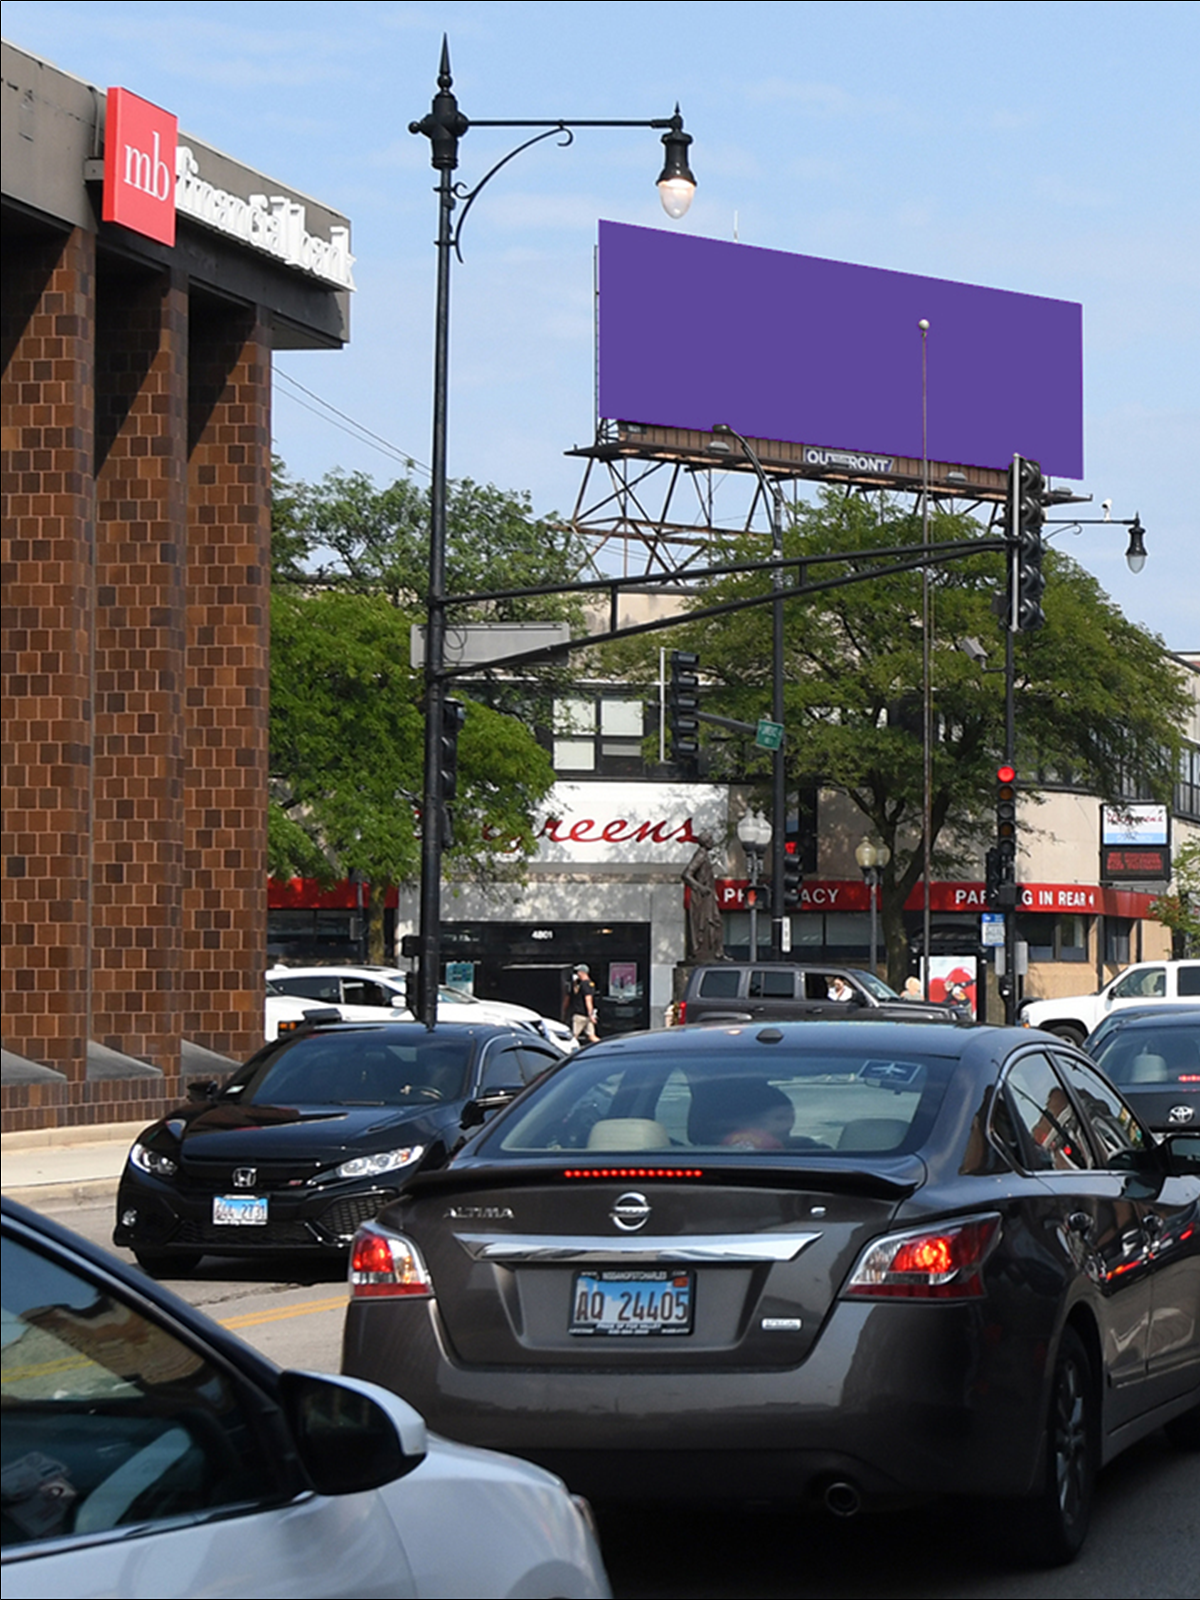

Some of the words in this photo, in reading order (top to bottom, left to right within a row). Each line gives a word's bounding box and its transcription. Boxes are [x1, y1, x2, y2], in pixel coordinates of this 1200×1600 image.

[123, 130, 171, 202] mb
[286, 201, 357, 292] bank
[806, 449, 890, 472] OURONT
[1039, 890, 1054, 905] IN
[1058, 890, 1086, 907] REAR
[443, 1207, 515, 1219] ALTIMA
[576, 1290, 605, 1321] AQ
[618, 1290, 688, 1321] 24405
